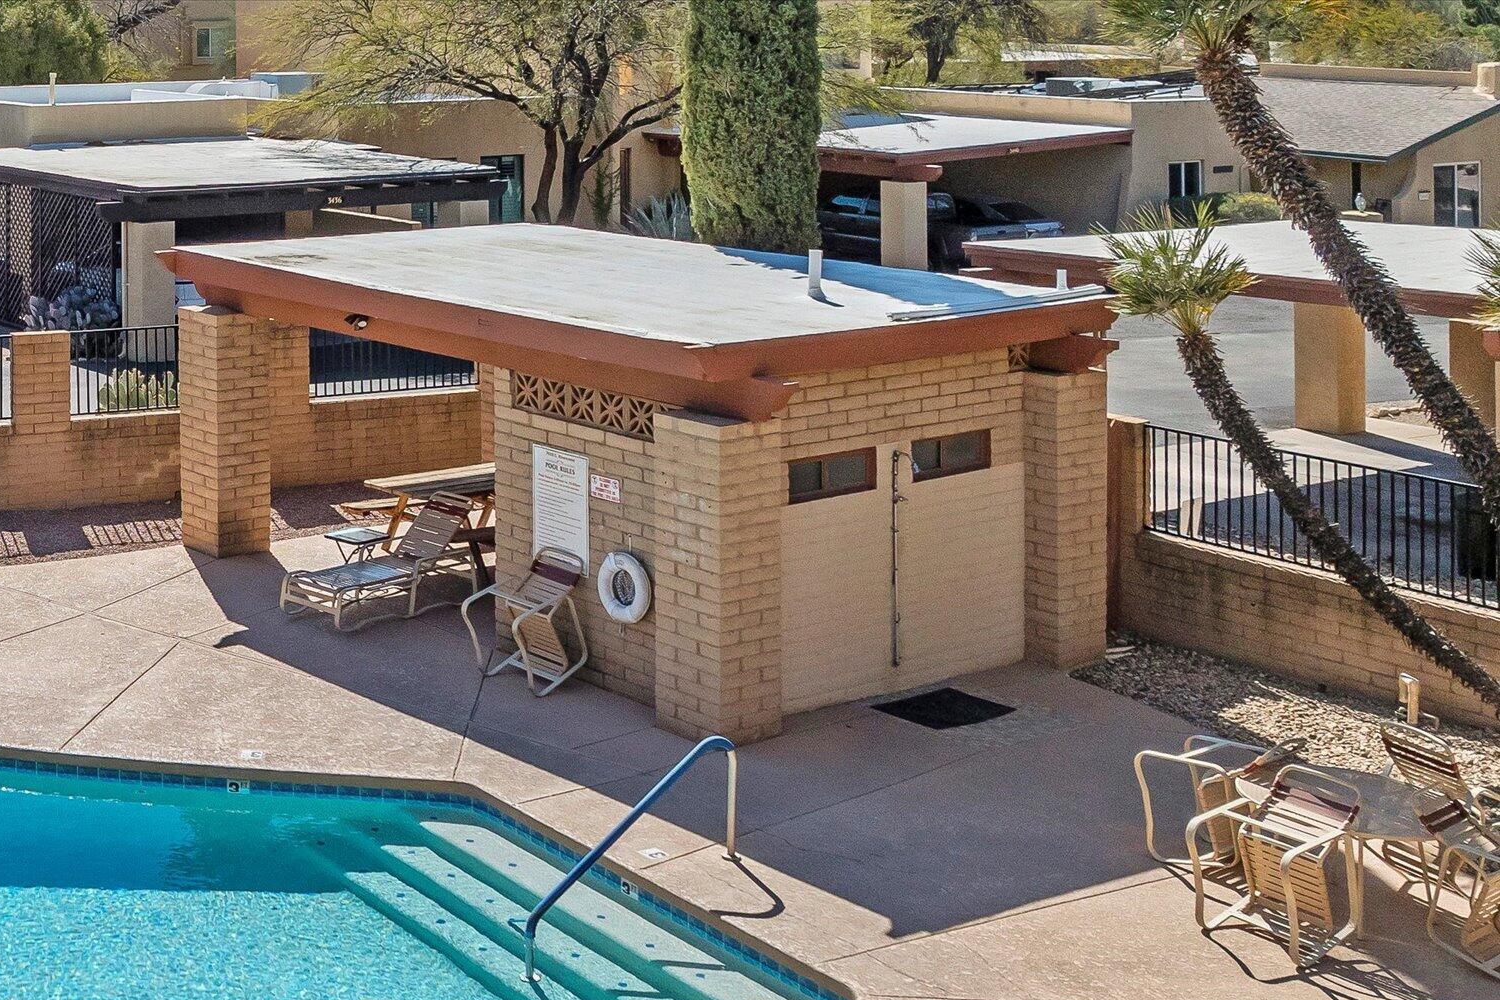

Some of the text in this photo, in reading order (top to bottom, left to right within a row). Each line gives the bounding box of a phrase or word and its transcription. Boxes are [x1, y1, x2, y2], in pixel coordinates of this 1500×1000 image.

[545, 461, 576, 475] POOL RULES
[228, 781, 240, 793] 3
[622, 881, 631, 895] 3
